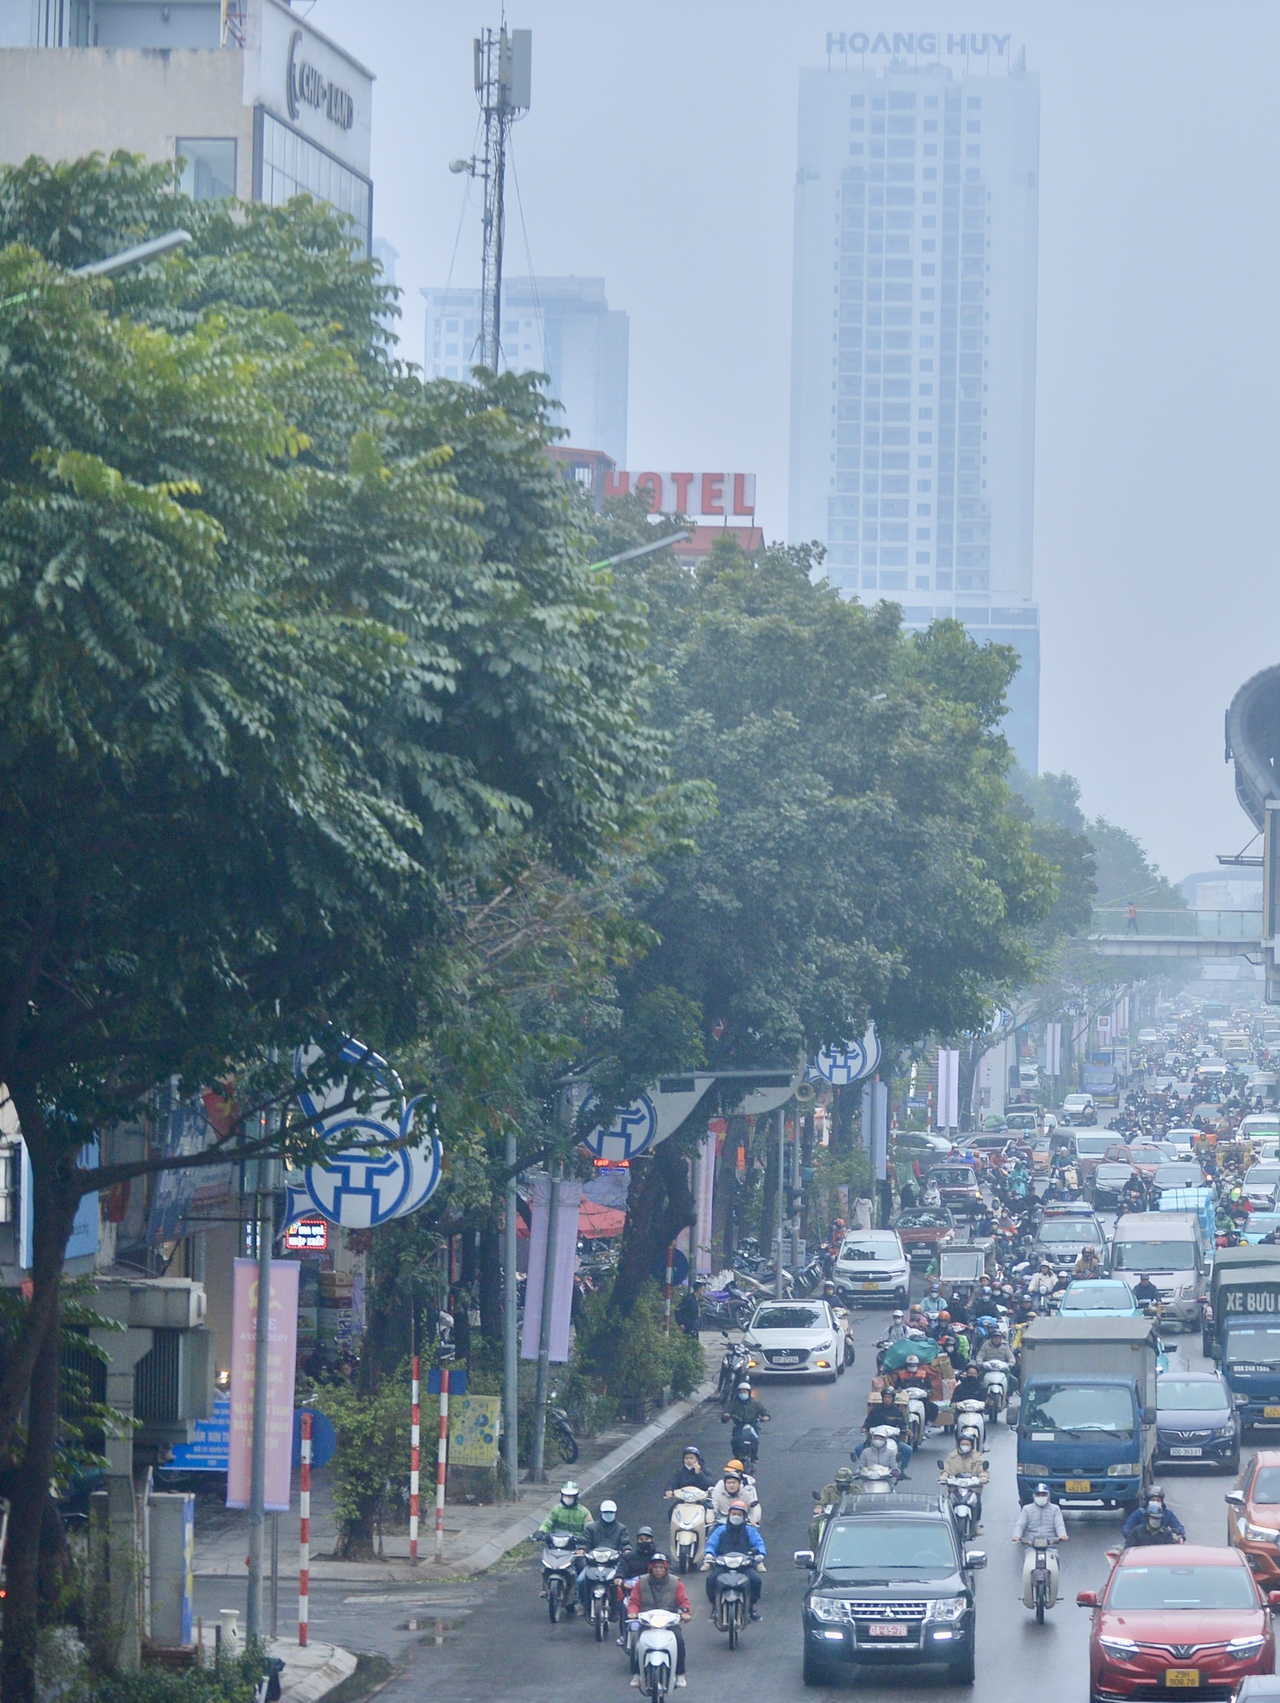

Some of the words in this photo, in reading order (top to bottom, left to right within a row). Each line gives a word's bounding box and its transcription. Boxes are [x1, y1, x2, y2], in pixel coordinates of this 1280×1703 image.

[826, 31, 937, 54] HOANG
[947, 33, 1012, 55] HUY
[604, 471, 755, 515] HOTEL
[1226, 1292, 1243, 1311] XE
[1246, 1291, 1275, 1312] BƯU
[870, 1626, 907, 1635] QA-65-78
[1175, 1670, 1190, 1678] 29H
